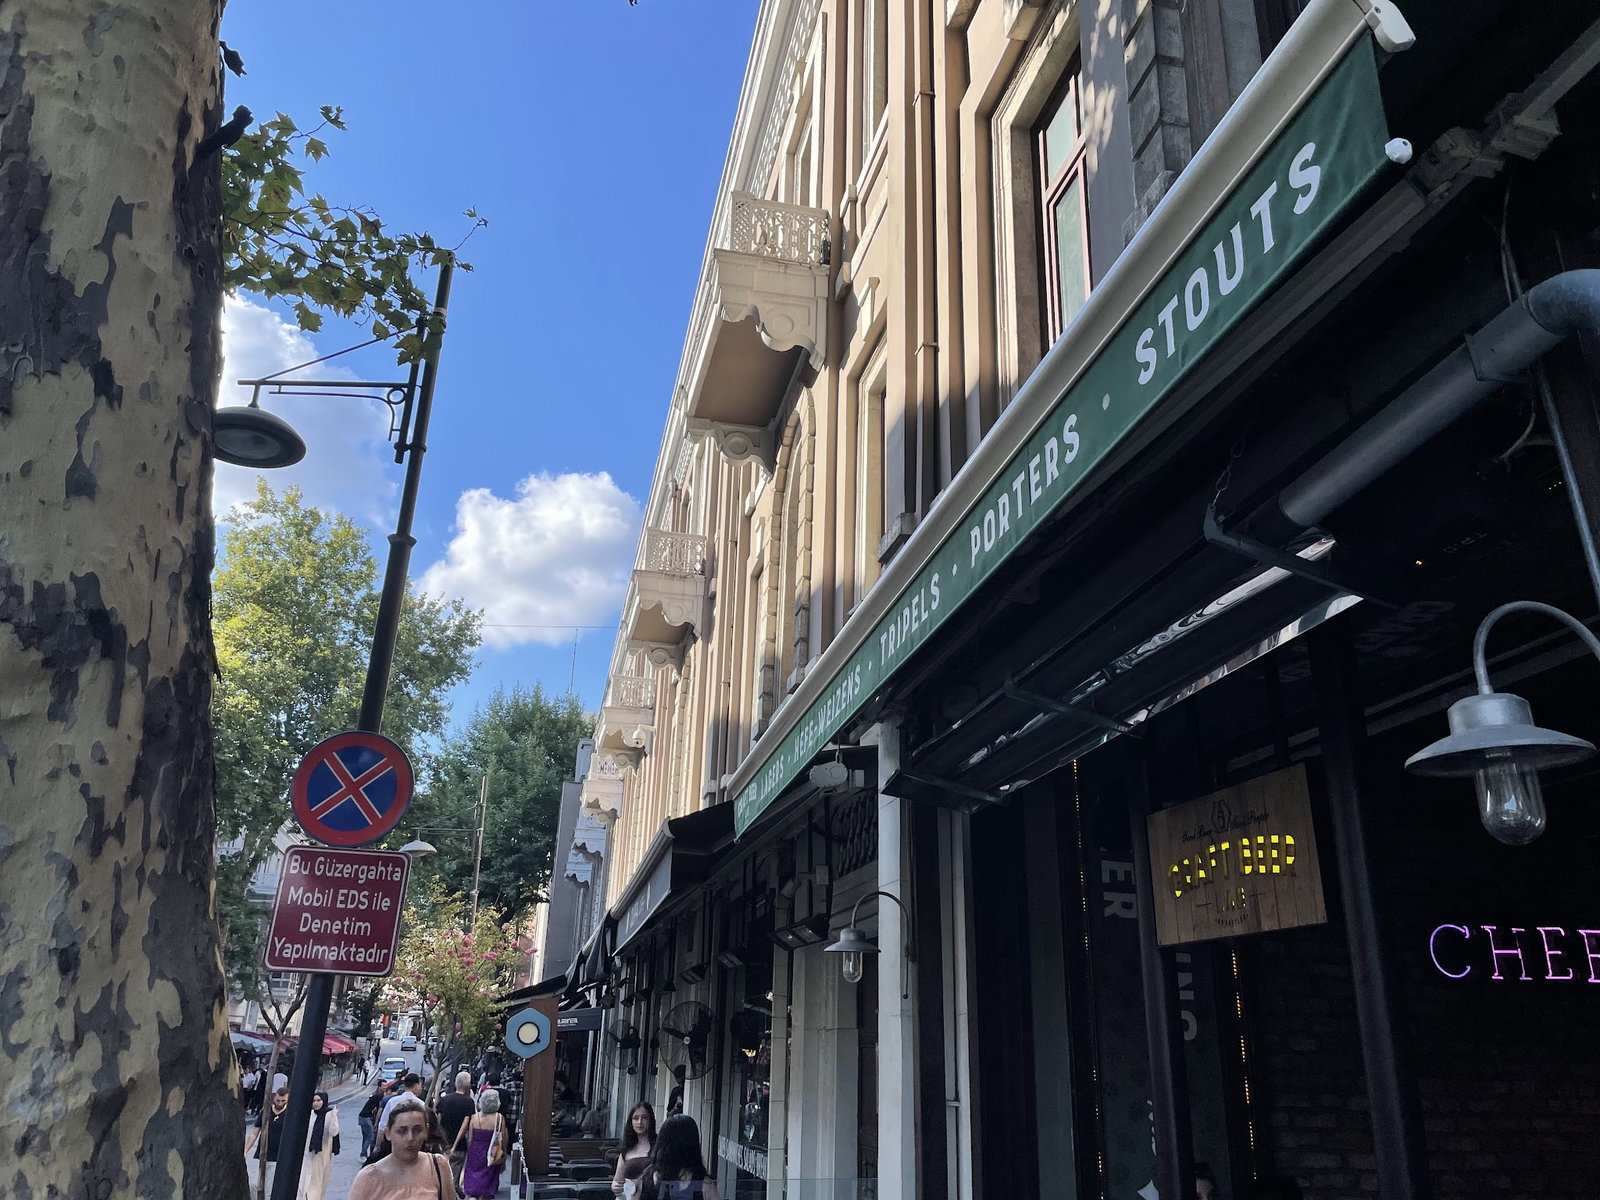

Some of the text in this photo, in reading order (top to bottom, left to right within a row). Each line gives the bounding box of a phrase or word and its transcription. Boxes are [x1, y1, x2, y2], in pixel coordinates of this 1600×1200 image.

[794, 664, 861, 763] HEFE-WEIZENS
[880, 572, 940, 666] TRIPELS
[970, 413, 1080, 568] PORTERS
[1135, 142, 1321, 385] STOUTS
[289, 855, 401, 884] Bu Güzergahta
[288, 886, 391, 911] Mobil EDS ile
[299, 913, 371, 936] Denetim
[274, 937, 388, 964] Yapılmaktadır
